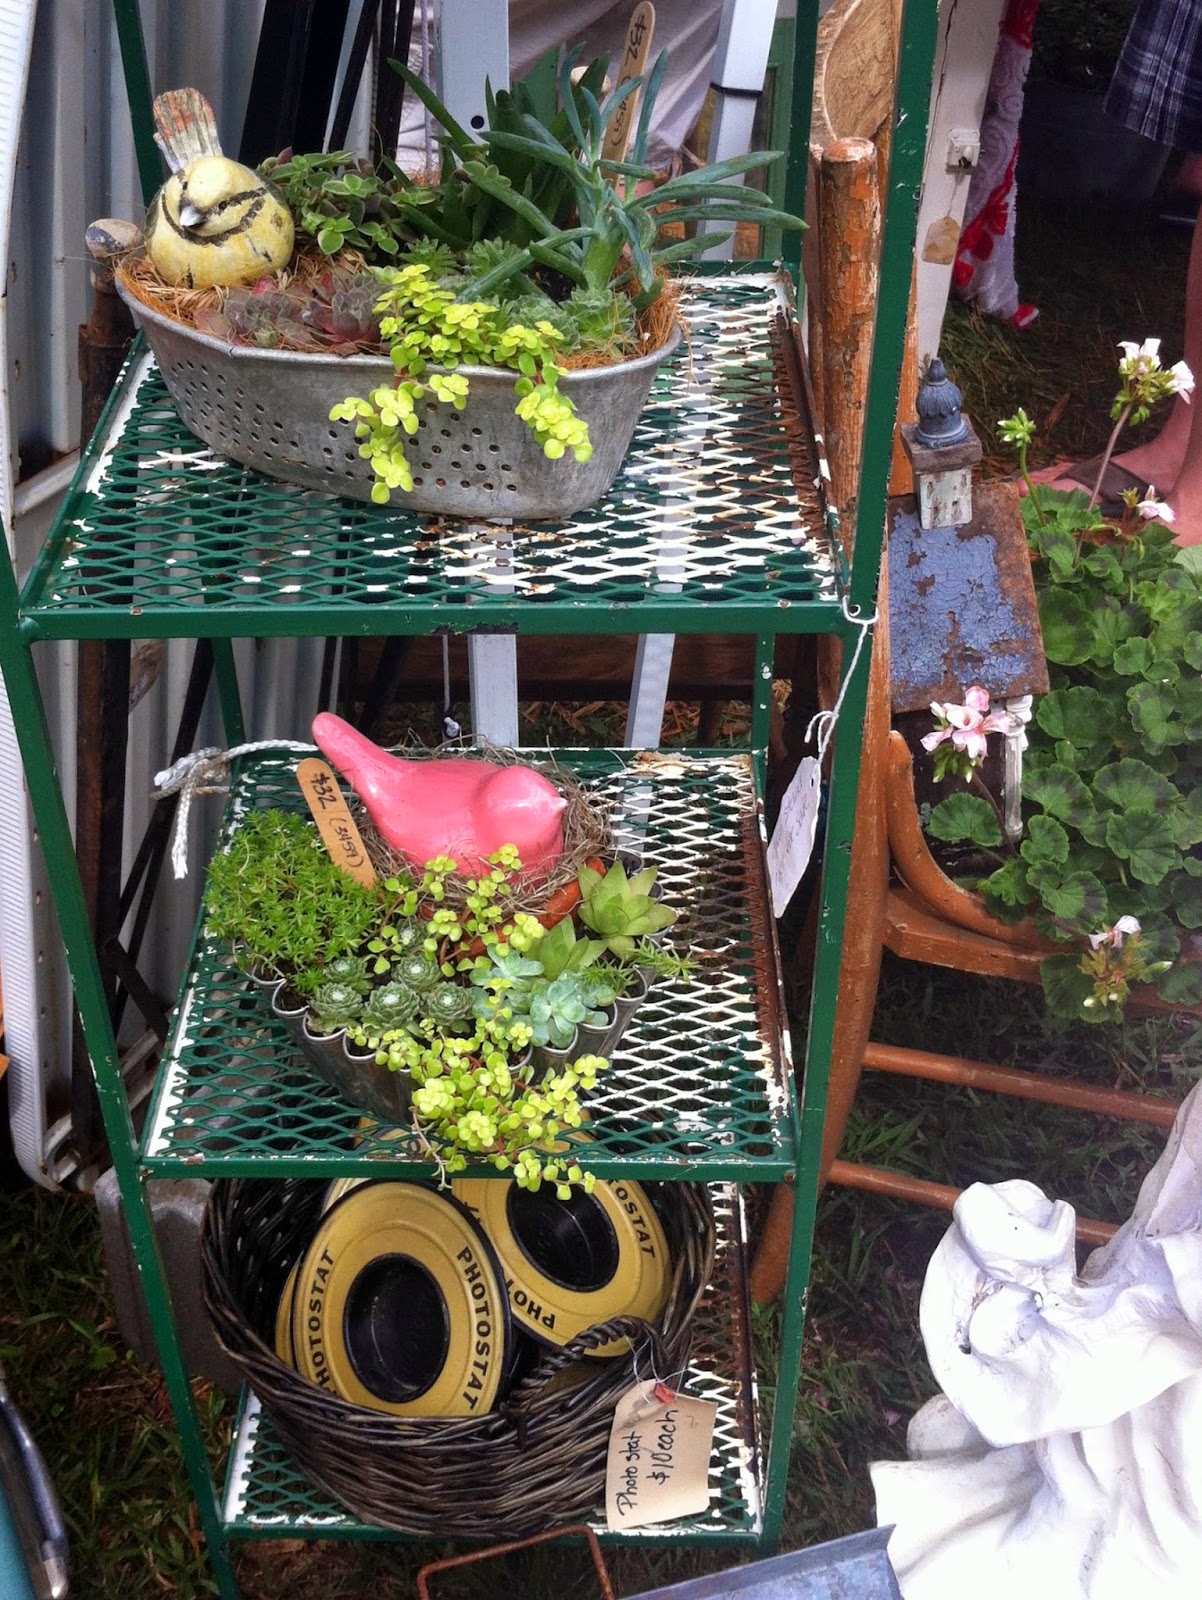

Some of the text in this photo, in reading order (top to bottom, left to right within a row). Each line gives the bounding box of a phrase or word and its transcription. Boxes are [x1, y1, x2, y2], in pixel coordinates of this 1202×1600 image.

[625, 14, 647, 66] $32
[310, 772, 337, 810] $32
[456, 1246, 491, 1411] PHOTOSTAT
[616, 1464, 639, 1516] Photo
